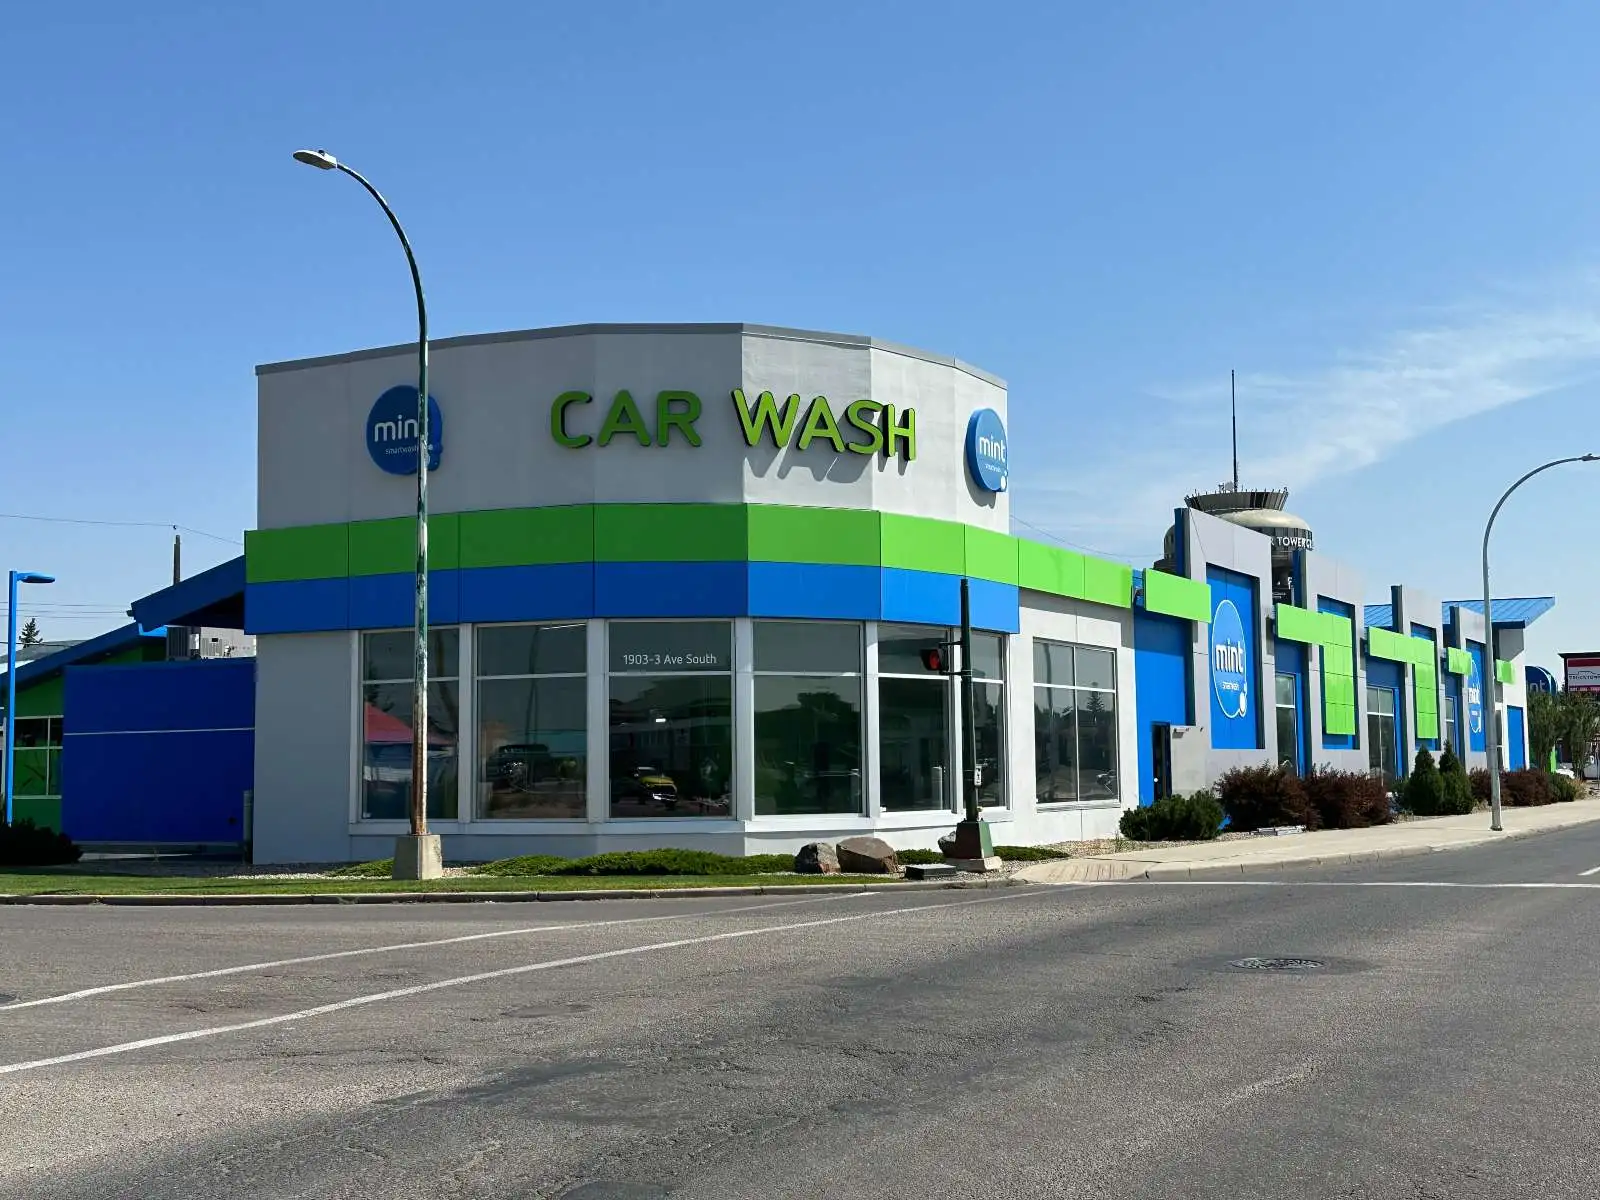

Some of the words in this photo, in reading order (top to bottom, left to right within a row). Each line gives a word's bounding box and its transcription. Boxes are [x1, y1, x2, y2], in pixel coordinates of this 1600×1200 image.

[374, 414, 419, 442] min
[551, 389, 702, 448] CAR
[730, 387, 916, 462] WASH
[979, 434, 1006, 463] mint
[623, 654, 661, 665] 1903-3
[663, 654, 683, 665] Ave
[686, 653, 717, 664] South
[1216, 638, 1244, 673] mint
